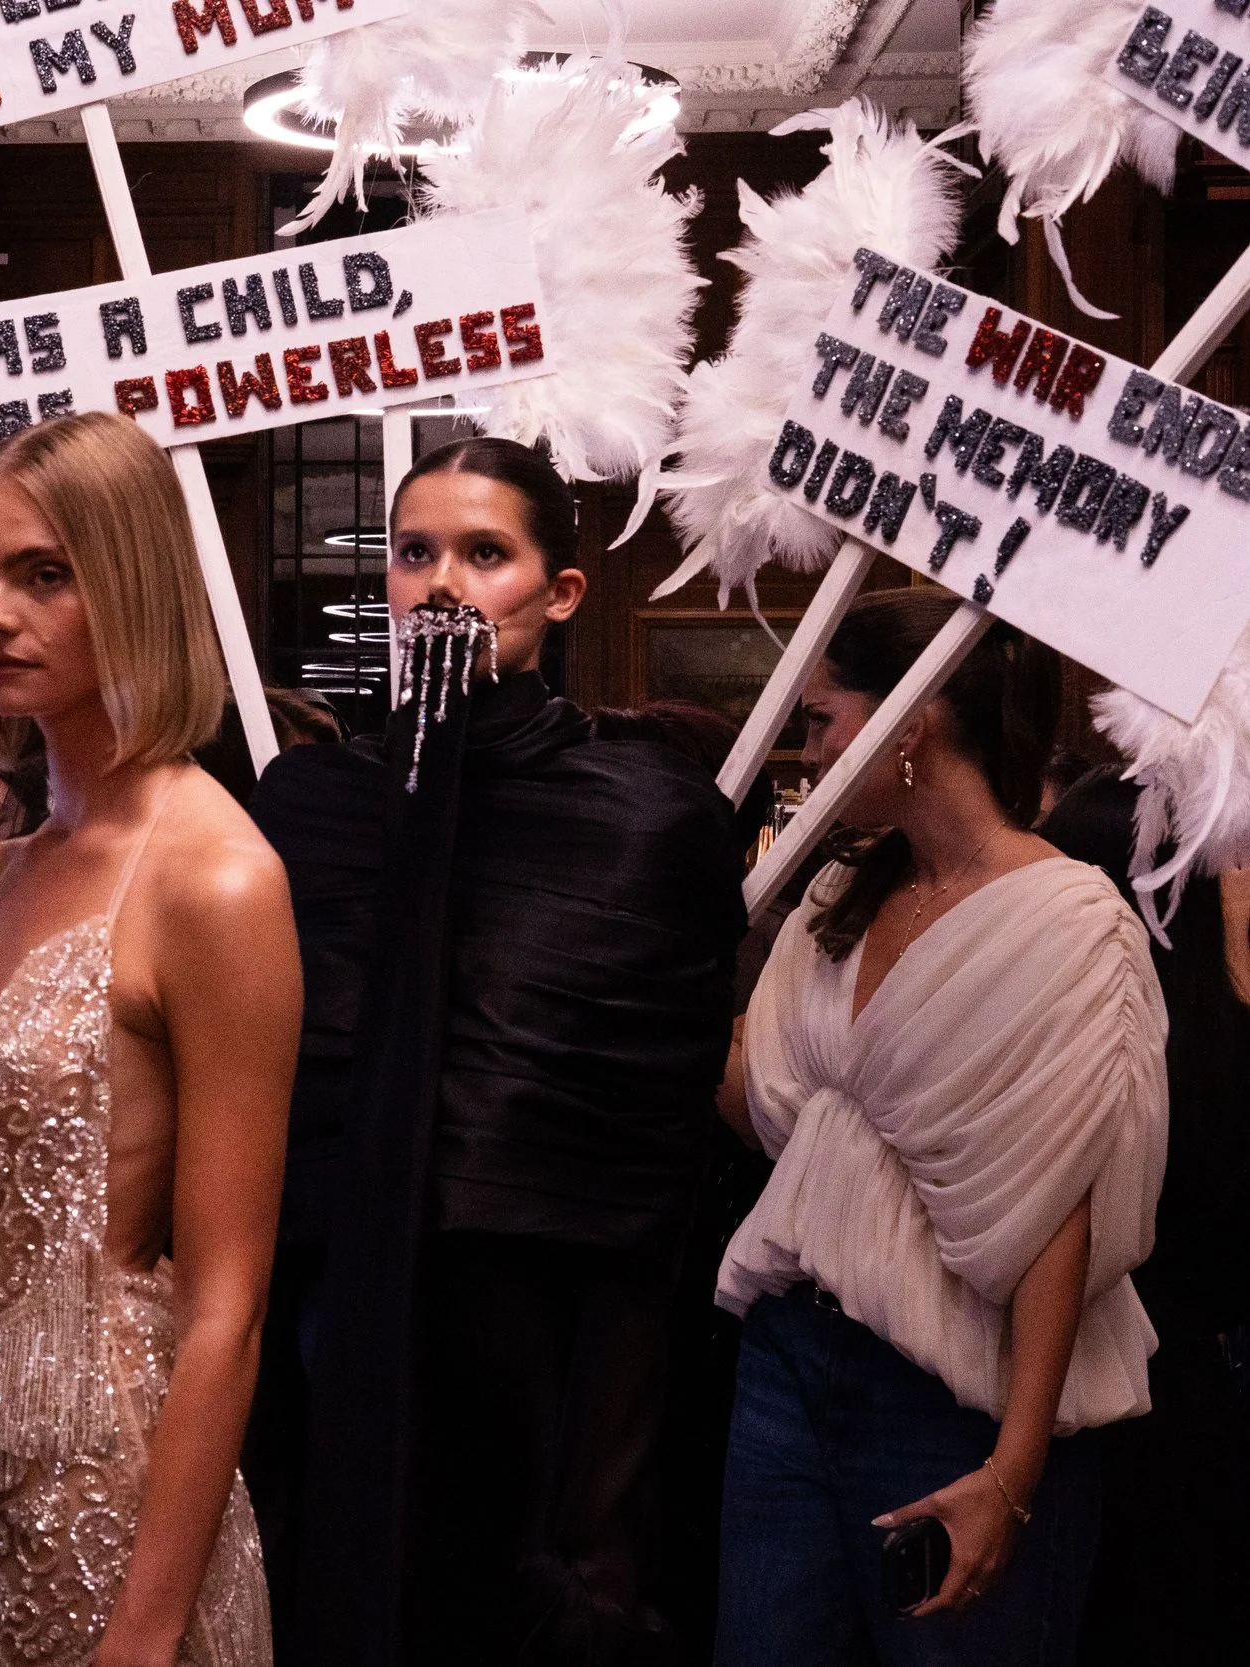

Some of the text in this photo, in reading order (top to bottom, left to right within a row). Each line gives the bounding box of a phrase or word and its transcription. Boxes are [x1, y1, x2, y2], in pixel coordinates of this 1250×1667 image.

[29, 13, 136, 94] MY
[99, 296, 148, 359] A
[176, 251, 414, 347] CHILD,
[114, 302, 544, 429] POWERLESS
[853, 248, 968, 358] THE
[965, 305, 1107, 422] WAR
[812, 332, 1190, 569] THE MEMORY
